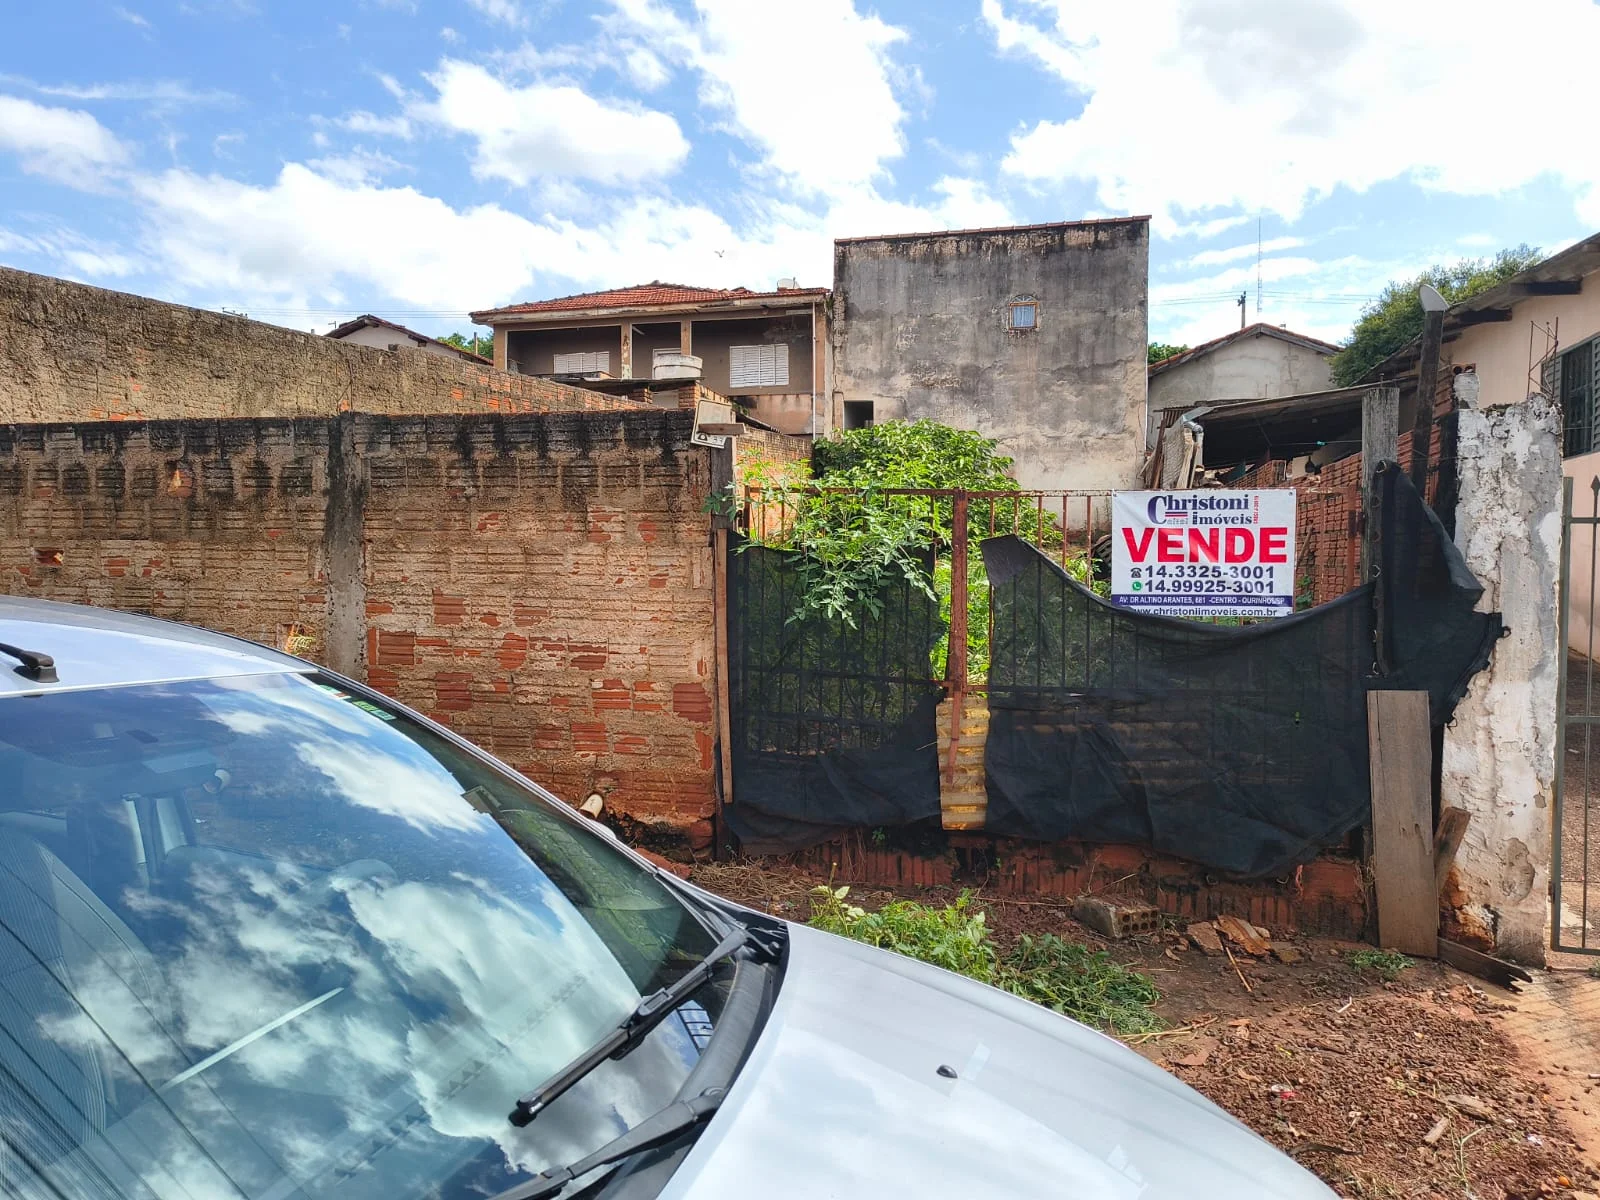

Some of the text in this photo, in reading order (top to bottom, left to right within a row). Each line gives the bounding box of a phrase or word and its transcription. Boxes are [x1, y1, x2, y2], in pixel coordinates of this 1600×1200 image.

[1148, 494, 1249, 525] Christoni
[1122, 527, 1288, 563] VENDE
[1145, 565, 1274, 579] 14.3325-3001
[1145, 580, 1274, 593] 14.99925-3001
[1134, 607, 1277, 616] ww.christoniimoveis.com.br
